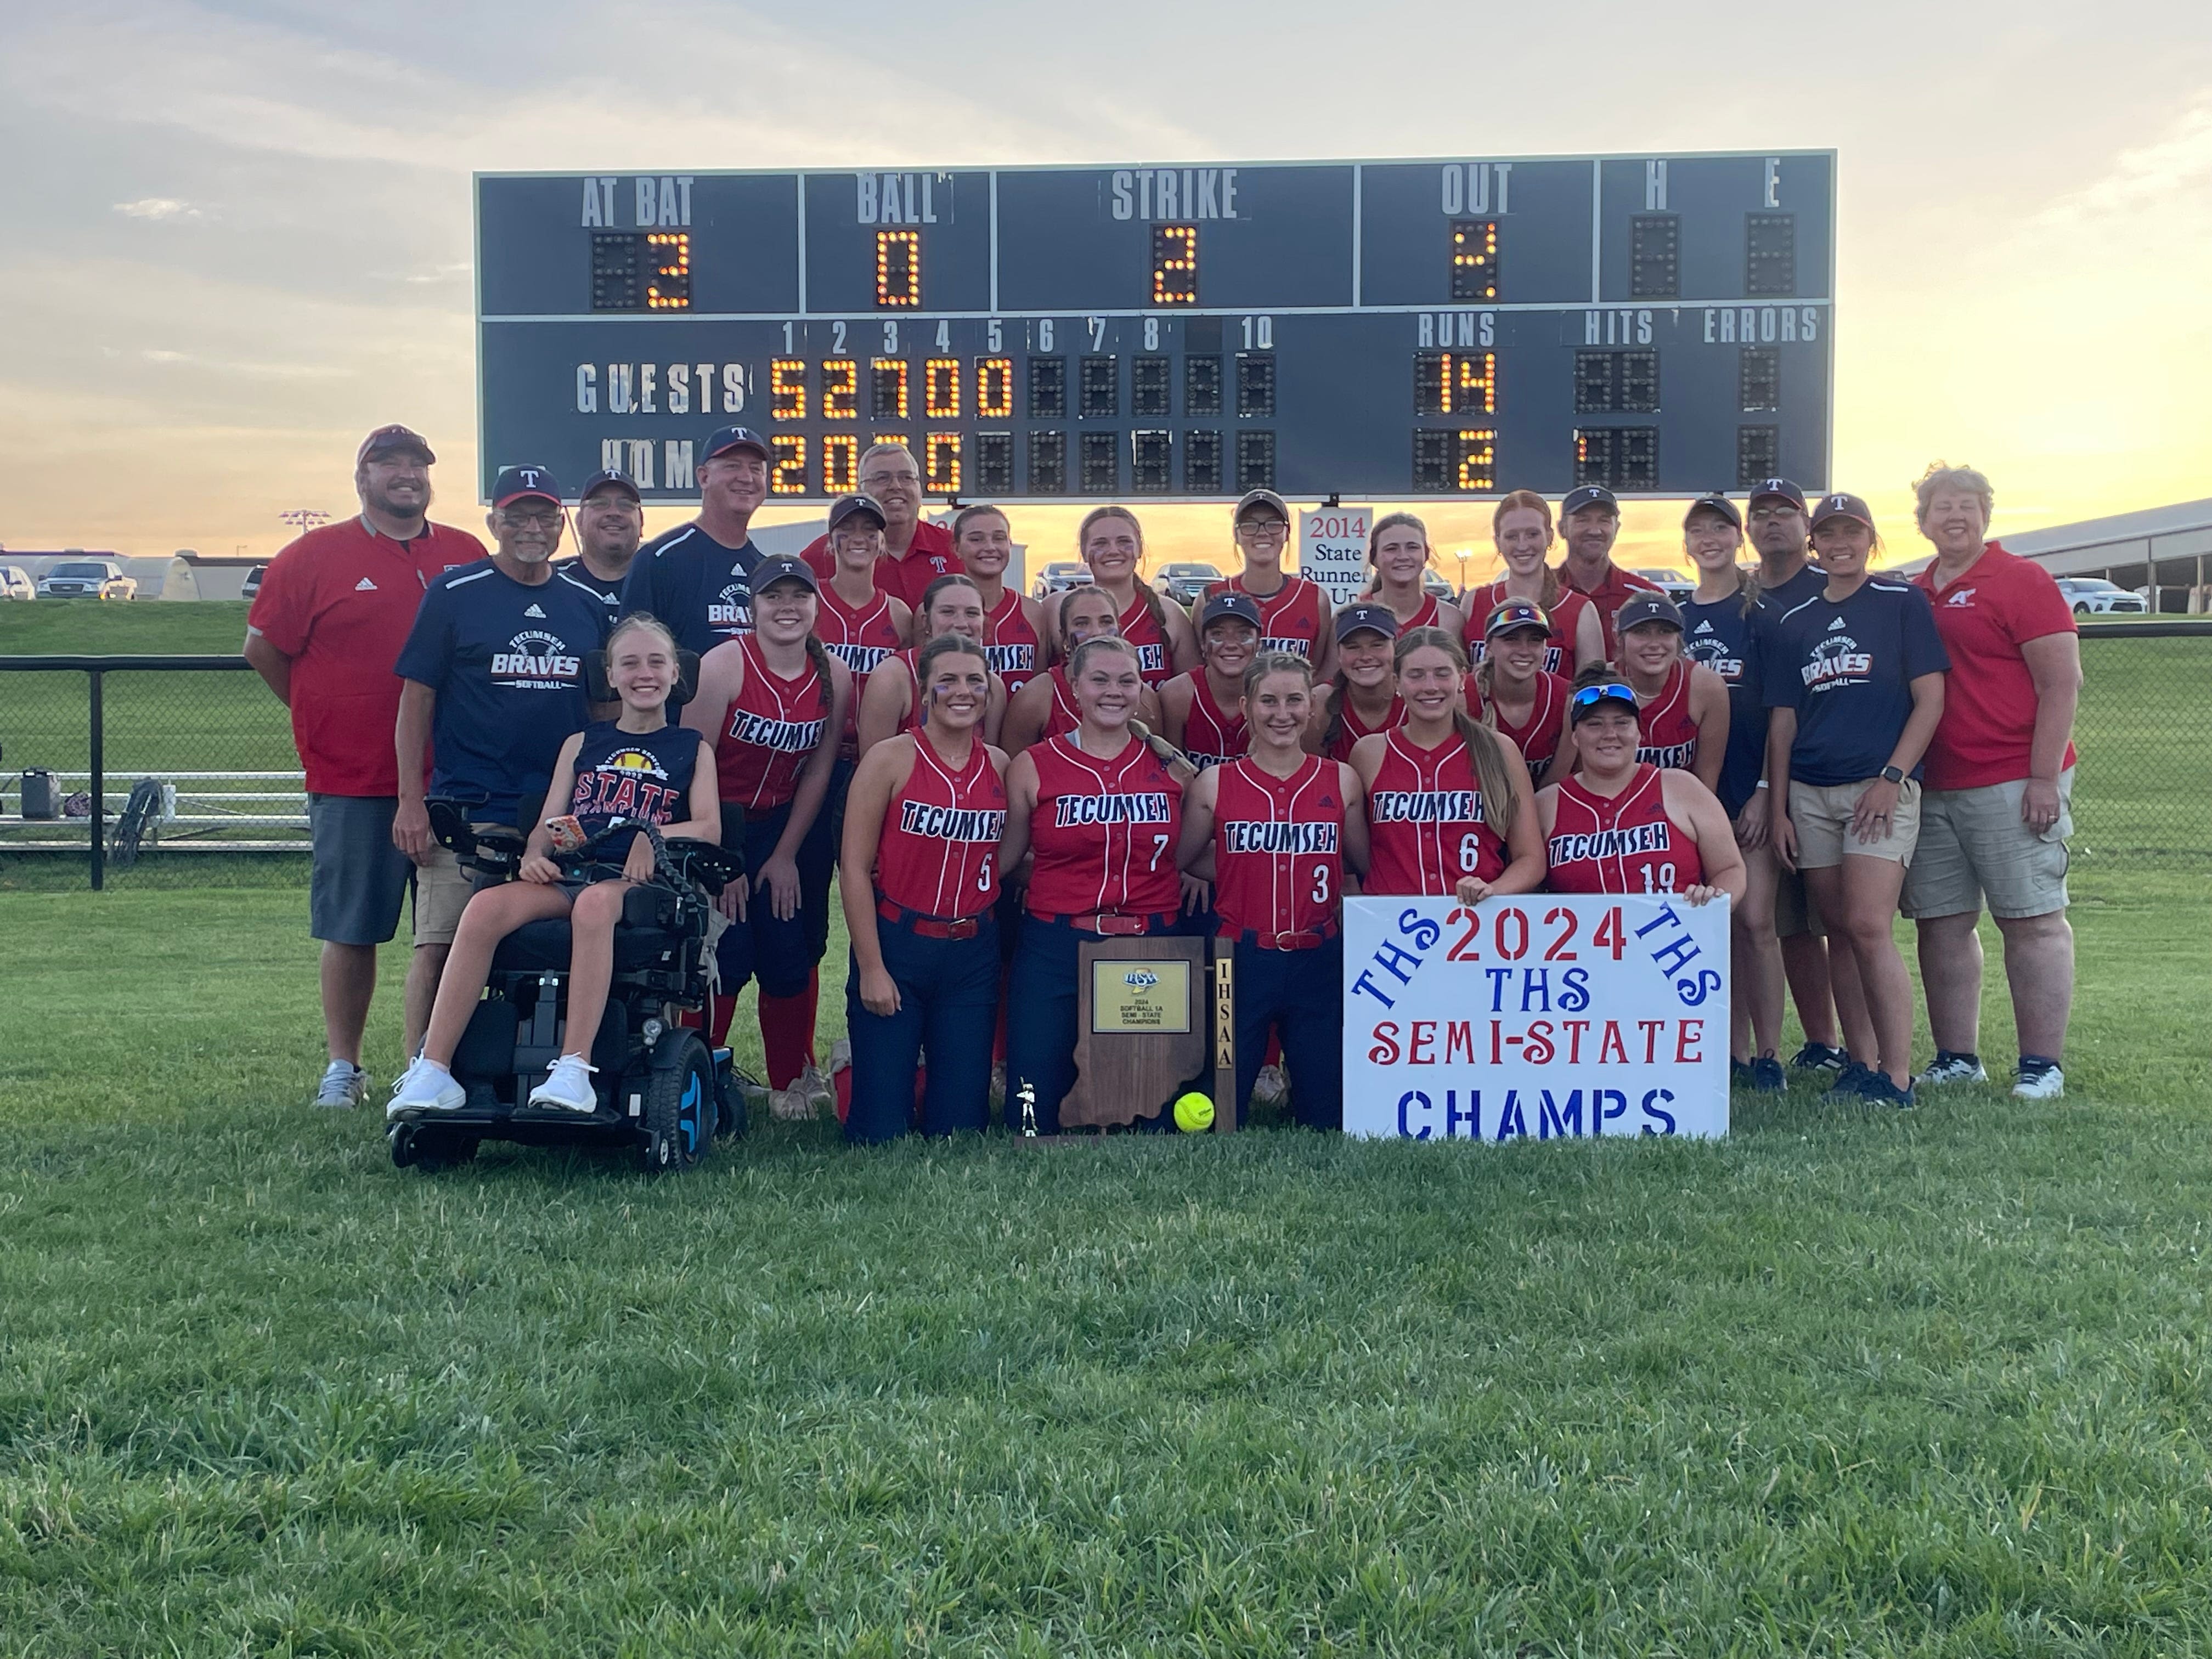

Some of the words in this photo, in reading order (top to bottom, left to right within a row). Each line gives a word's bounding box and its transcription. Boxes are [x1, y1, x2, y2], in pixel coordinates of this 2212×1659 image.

[857, 173, 937, 224] BALL
[1112, 169, 1237, 219] STRIKE
[1441, 163, 1513, 215] OUT
[1646, 159, 1667, 210] H
[1765, 157, 1780, 208] E
[581, 177, 617, 227] AT
[636, 177, 694, 226] BAT
[647, 233, 689, 308] 2
[877, 231, 919, 306] 0
[1153, 227, 1197, 303] 2
[783, 323, 793, 352] 1
[833, 320, 847, 354] 2
[884, 320, 898, 353] 3
[935, 320, 950, 353] 4
[988, 319, 1002, 352] 5
[1040, 319, 1053, 352] 6
[1093, 318, 1106, 351] 7
[1144, 317, 1159, 351] 8
[1242, 316, 1272, 349] 10
[1418, 313, 1495, 347] RUNS
[1585, 311, 1653, 345] HITS
[1705, 307, 1817, 343] ERRORS
[576, 362, 745, 414] GUESTS
[771, 360, 806, 419] 5
[823, 360, 858, 419] 2
[874, 360, 909, 418] 7
[926, 359, 960, 419] 0
[978, 358, 1012, 417] 0
[1441, 352, 1496, 413] 14
[732, 427, 747, 440] T
[520, 470, 539, 488] T
[602, 439, 693, 489] HOM
[605, 469, 621, 480] T
[771, 436, 806, 493] 2
[823, 435, 858, 493] 0
[1458, 430, 1494, 490] 2
[855, 498, 867, 506] T
[1589, 489, 1600, 498] T
[1767, 479, 1783, 492] T
[1831, 495, 1847, 511] T
[1310, 517, 1365, 538] 2014
[781, 563, 793, 573] T
[930, 556, 947, 573] T
[1315, 544, 1362, 561] State
[1301, 566, 1368, 583] Runner
[1224, 597, 1235, 608] T
[1357, 610, 1368, 620] T
[1648, 603, 1659, 613] T
[509, 631, 566, 651] TECUMSEH
[1683, 638, 1729, 654] ECUMSEH
[491, 654, 581, 676] BRAVES
[1801, 653, 1871, 686] BRAVES
[516, 680, 562, 689] SOFTBALL
[729, 708, 826, 753] TECUMSE
[575, 772, 680, 821] STATE
[1056, 793, 1171, 828] TECUMSEH
[1373, 791, 1485, 823] TECUMSEH
[900, 800, 1007, 843] TECUMSEH
[1224, 822, 1338, 854] TECUMSEH
[1150, 834, 1169, 871] 7
[1459, 833, 1479, 872] 6
[1549, 822, 1670, 868] TECUMSEH
[978, 853, 993, 891] 5
[1312, 865, 1329, 904] 3
[1446, 906, 1627, 962] 2024
[1351, 908, 1441, 1011] THS
[1634, 901, 1722, 1007] THS
[1486, 968, 1590, 1012] THS
[1218, 963, 1231, 1065] IHSAA
[1368, 1020, 1705, 1065] SEMI-STATE
[1398, 1089, 1677, 1141] CHAMPS
